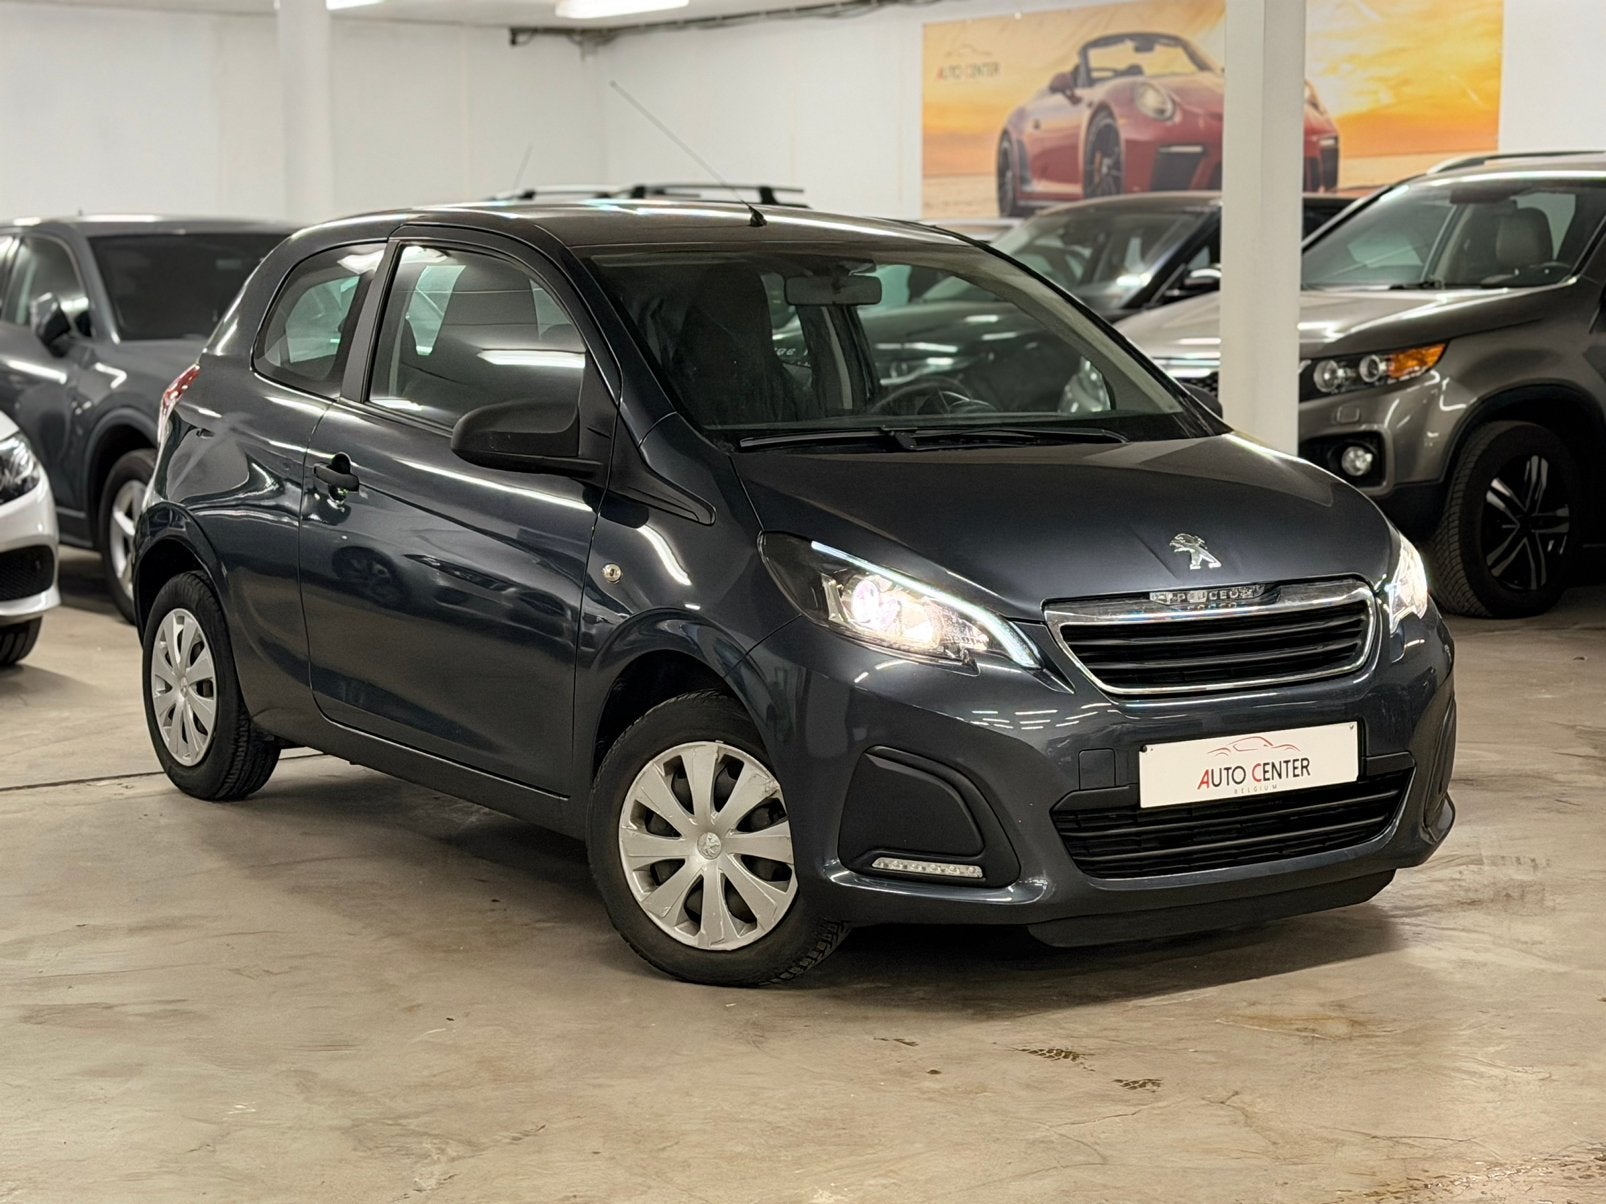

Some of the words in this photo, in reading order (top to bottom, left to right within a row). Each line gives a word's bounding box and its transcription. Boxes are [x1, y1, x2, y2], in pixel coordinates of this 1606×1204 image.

[1197, 765, 1247, 790] AUTO
[1252, 757, 1311, 783] CENTER
[1234, 783, 1278, 795] BELGIUM
